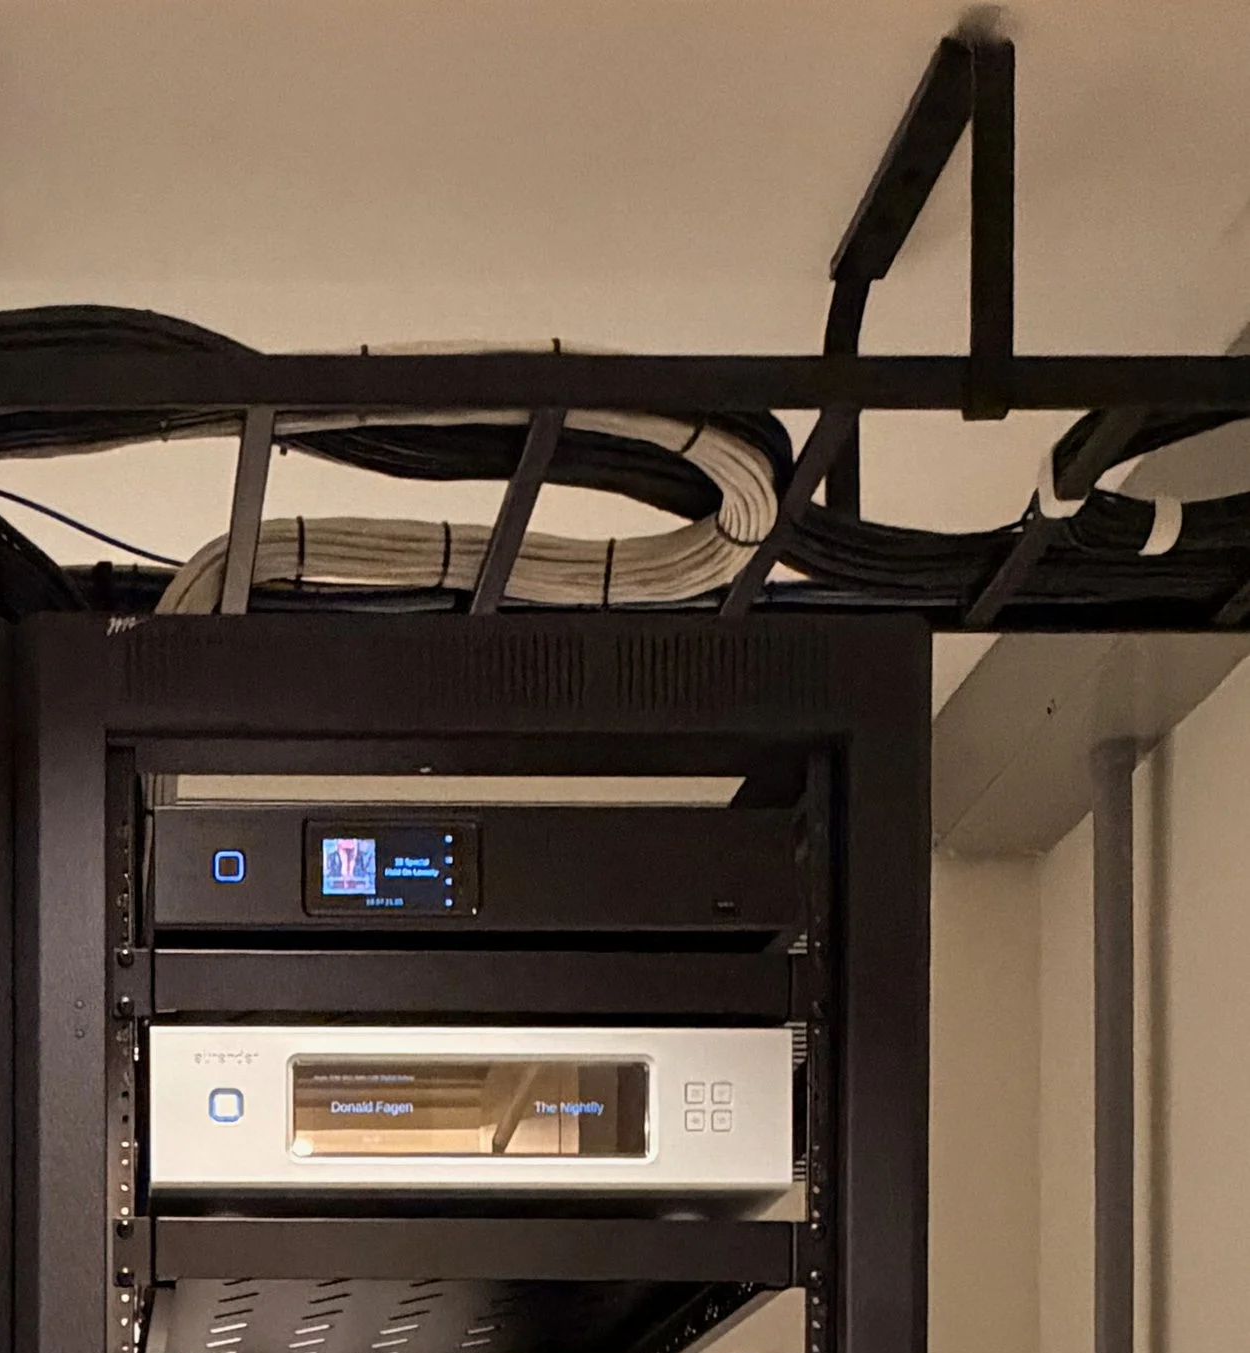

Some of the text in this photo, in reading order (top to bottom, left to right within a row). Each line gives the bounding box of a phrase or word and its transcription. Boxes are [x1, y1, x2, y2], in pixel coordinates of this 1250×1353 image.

[330, 1100, 414, 1116] Donald Fagen
[534, 1100, 605, 1116] The Nightfly
